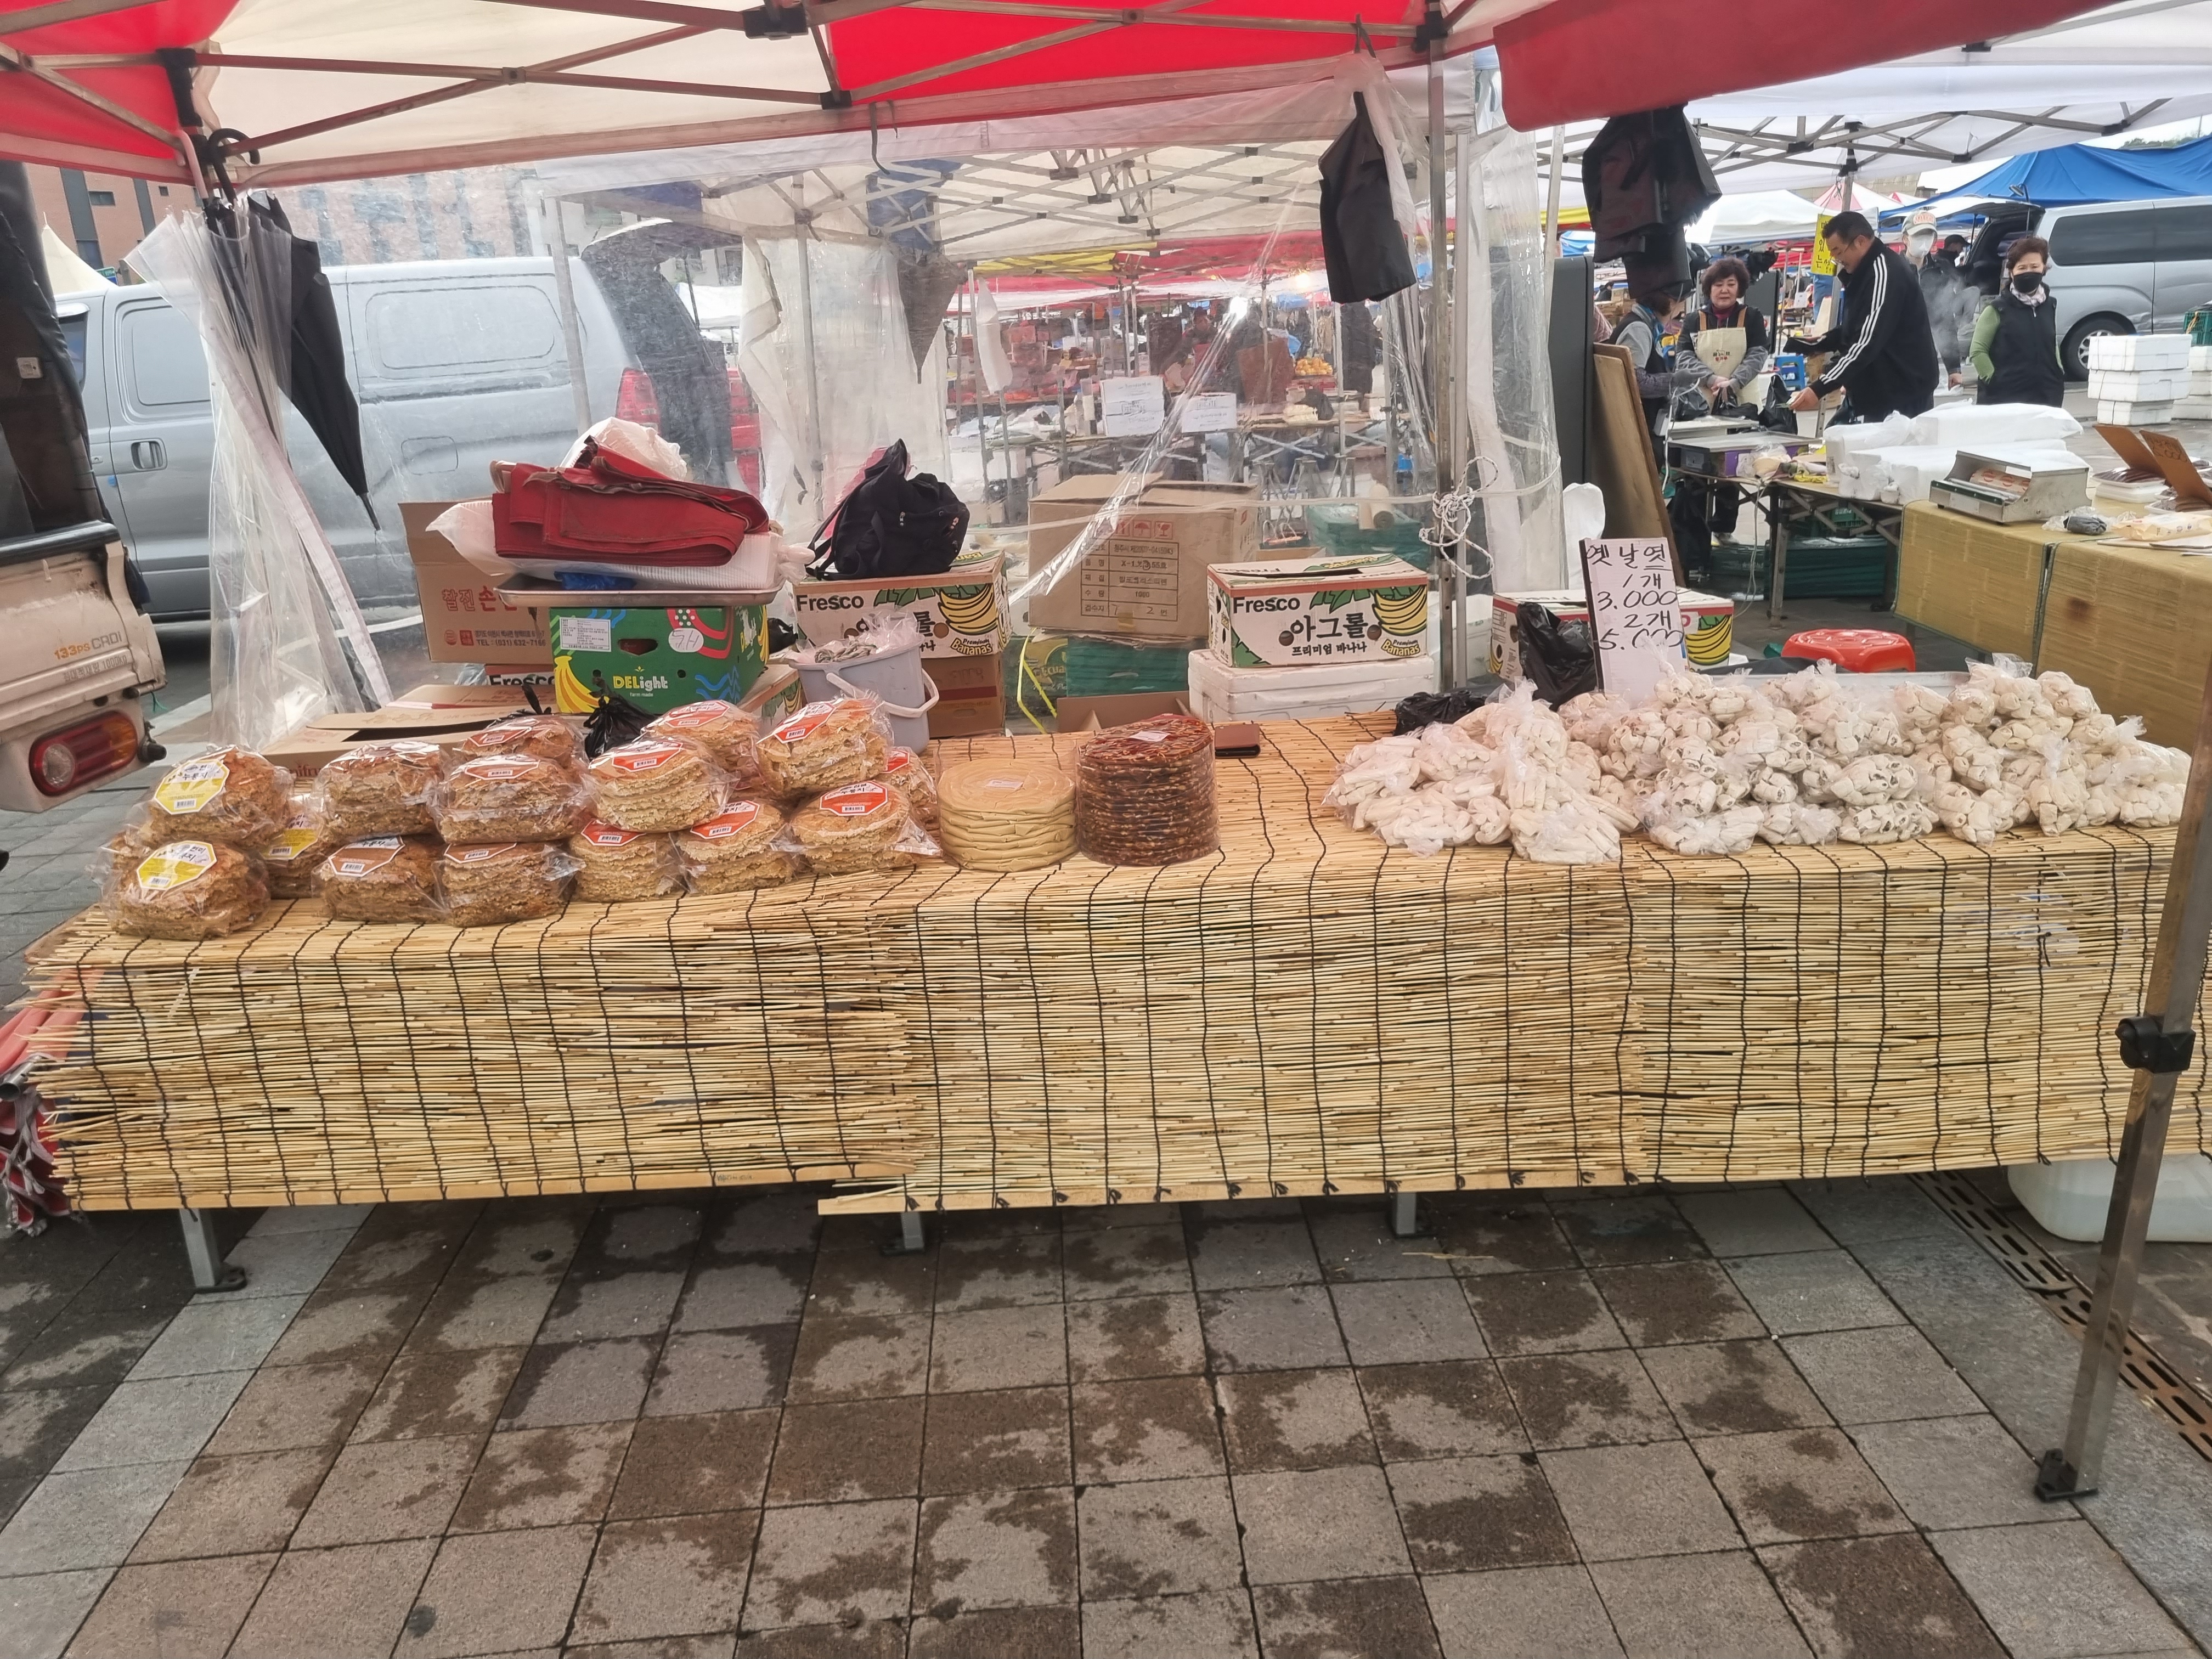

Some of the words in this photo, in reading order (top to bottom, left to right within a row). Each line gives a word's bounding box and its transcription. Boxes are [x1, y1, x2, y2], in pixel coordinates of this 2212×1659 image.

[796, 595, 865, 612] Fresco
[1233, 597, 1300, 614] Fresco
[1290, 612, 1368, 642] 아그롤
[951, 638, 992, 655] Bananas
[1291, 644, 1332, 657] 프리미엄
[1336, 641, 1367, 654] 바나나
[1381, 639, 1421, 657] Bananas
[613, 675, 668, 691] DELight
